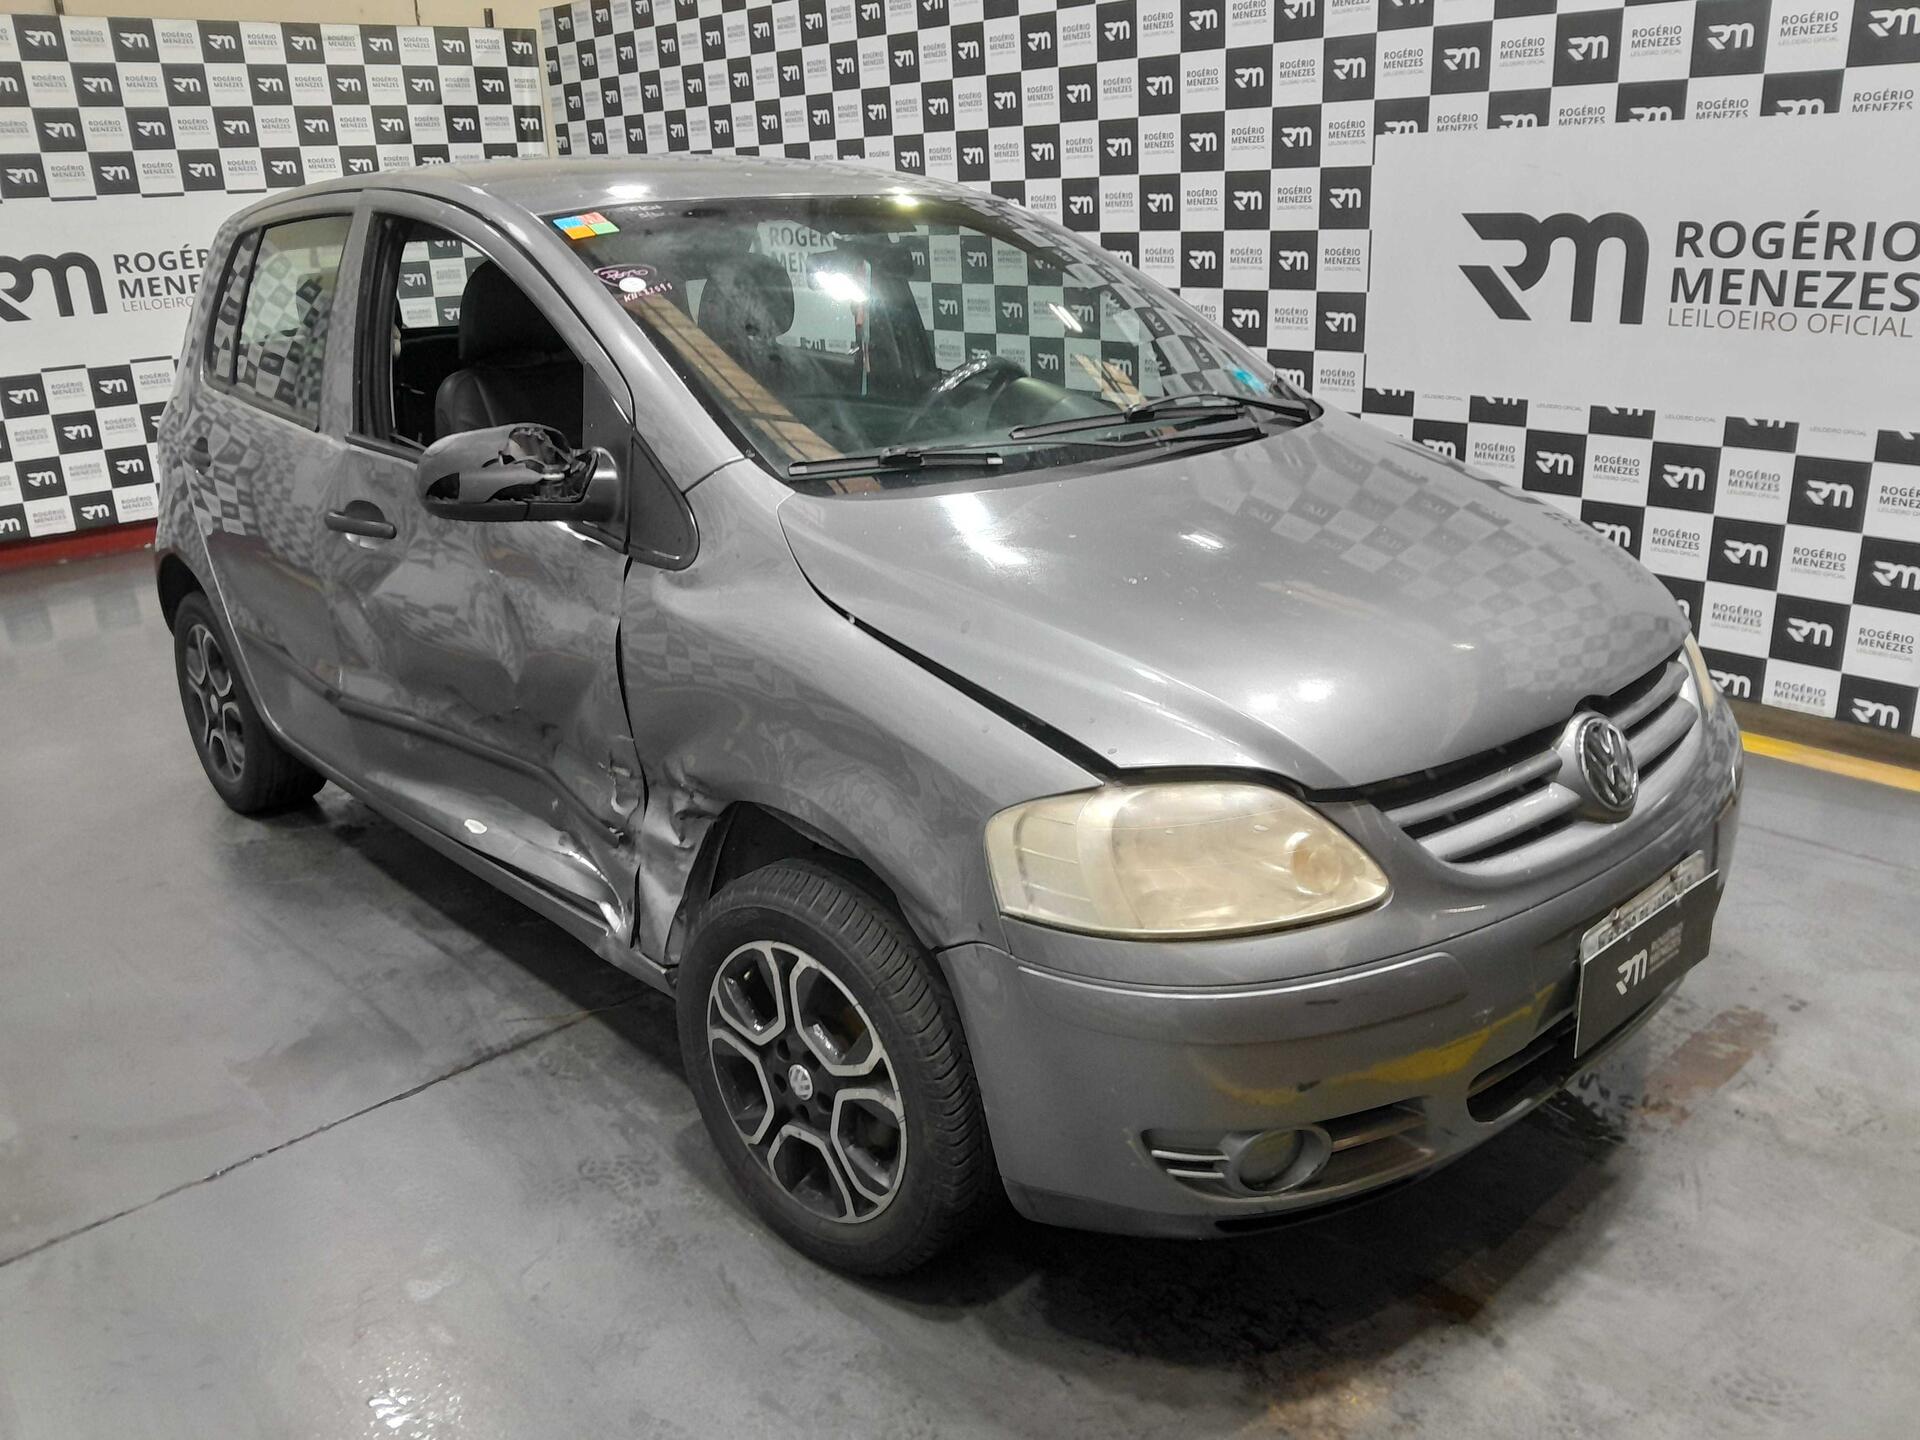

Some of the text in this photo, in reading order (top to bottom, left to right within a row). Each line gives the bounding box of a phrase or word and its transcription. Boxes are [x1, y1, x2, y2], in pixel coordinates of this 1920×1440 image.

[1232, 8, 1267, 20] MENEZES
[1781, 11, 1839, 25] ROGÉRIO
[1143, 20, 1174, 30] MENEZES
[1780, 22, 1838, 37] MENEZES
[1632, 25, 1682, 38] ROGÉRIO
[1500, 37, 1545, 49] ROGÉRIO
[1631, 36, 1681, 48] MENEZES
[1384, 48, 1423, 60] ROGÉRIO
[1500, 47, 1545, 59] MENEZES
[1383, 58, 1424, 70] MENEZES
[1280, 68, 1315, 78] MENEZES
[1186, 76, 1219, 87] MENEZES
[1103, 85, 1132, 94] MENEZES
[1853, 88, 1914, 102] ROGÉRIO
[1696, 98, 1749, 110] ROGÉRIO
[1559, 105, 1605, 117] ROGÉRIO
[1437, 113, 1478, 124] ROGÉRIO
[1231, 135, 1265, 144] MENEZES
[1328, 129, 1365, 139] MENEZES
[1144, 140, 1174, 149] MENEZES
[1105, 200, 1133, 208] MENEZES
[1186, 197, 1218, 206] MENEZES
[1277, 195, 1312, 204] MENEZES
[1674, 209, 1920, 262] ROGÉRIO
[113, 243, 210, 274] ROGÉR
[1230, 256, 1263, 264] MENEZES
[1324, 256, 1361, 265] MENEZES
[118, 273, 201, 299] MENE
[1669, 267, 1920, 312] MENEZES
[1274, 316, 1308, 324] MENEZES
[1668, 307, 1914, 338] LEILOEIRO OFICIAL
[1320, 377, 1355, 387] MENEZES
[1475, 442, 1516, 454] ROGÉRIO
[1474, 451, 1515, 463] MENEZES
[1594, 454, 1640, 467] ROGÉRIO
[1594, 464, 1639, 476] MENEZES
[1729, 469, 1781, 482] ROGÉRIO
[1728, 478, 1779, 492] MENEZES
[1881, 485, 1920, 498] ROGÉ
[1879, 495, 1920, 509] MENEZ
[1653, 527, 1700, 541] ROGÉRIO
[1651, 536, 1699, 550] MENEZES
[1793, 547, 1847, 562] ROGÉRIO
[1792, 556, 1845, 571] MENEZES
[1713, 602, 1762, 618] ROGÉRIO
[1712, 611, 1761, 627] MENEZES
[1859, 627, 1914, 644] ROGÉRIO
[1857, 637, 1913, 654] MENEZES
[1775, 680, 1826, 697] ROGÉRIO
[1774, 689, 1825, 707] MENEZES
